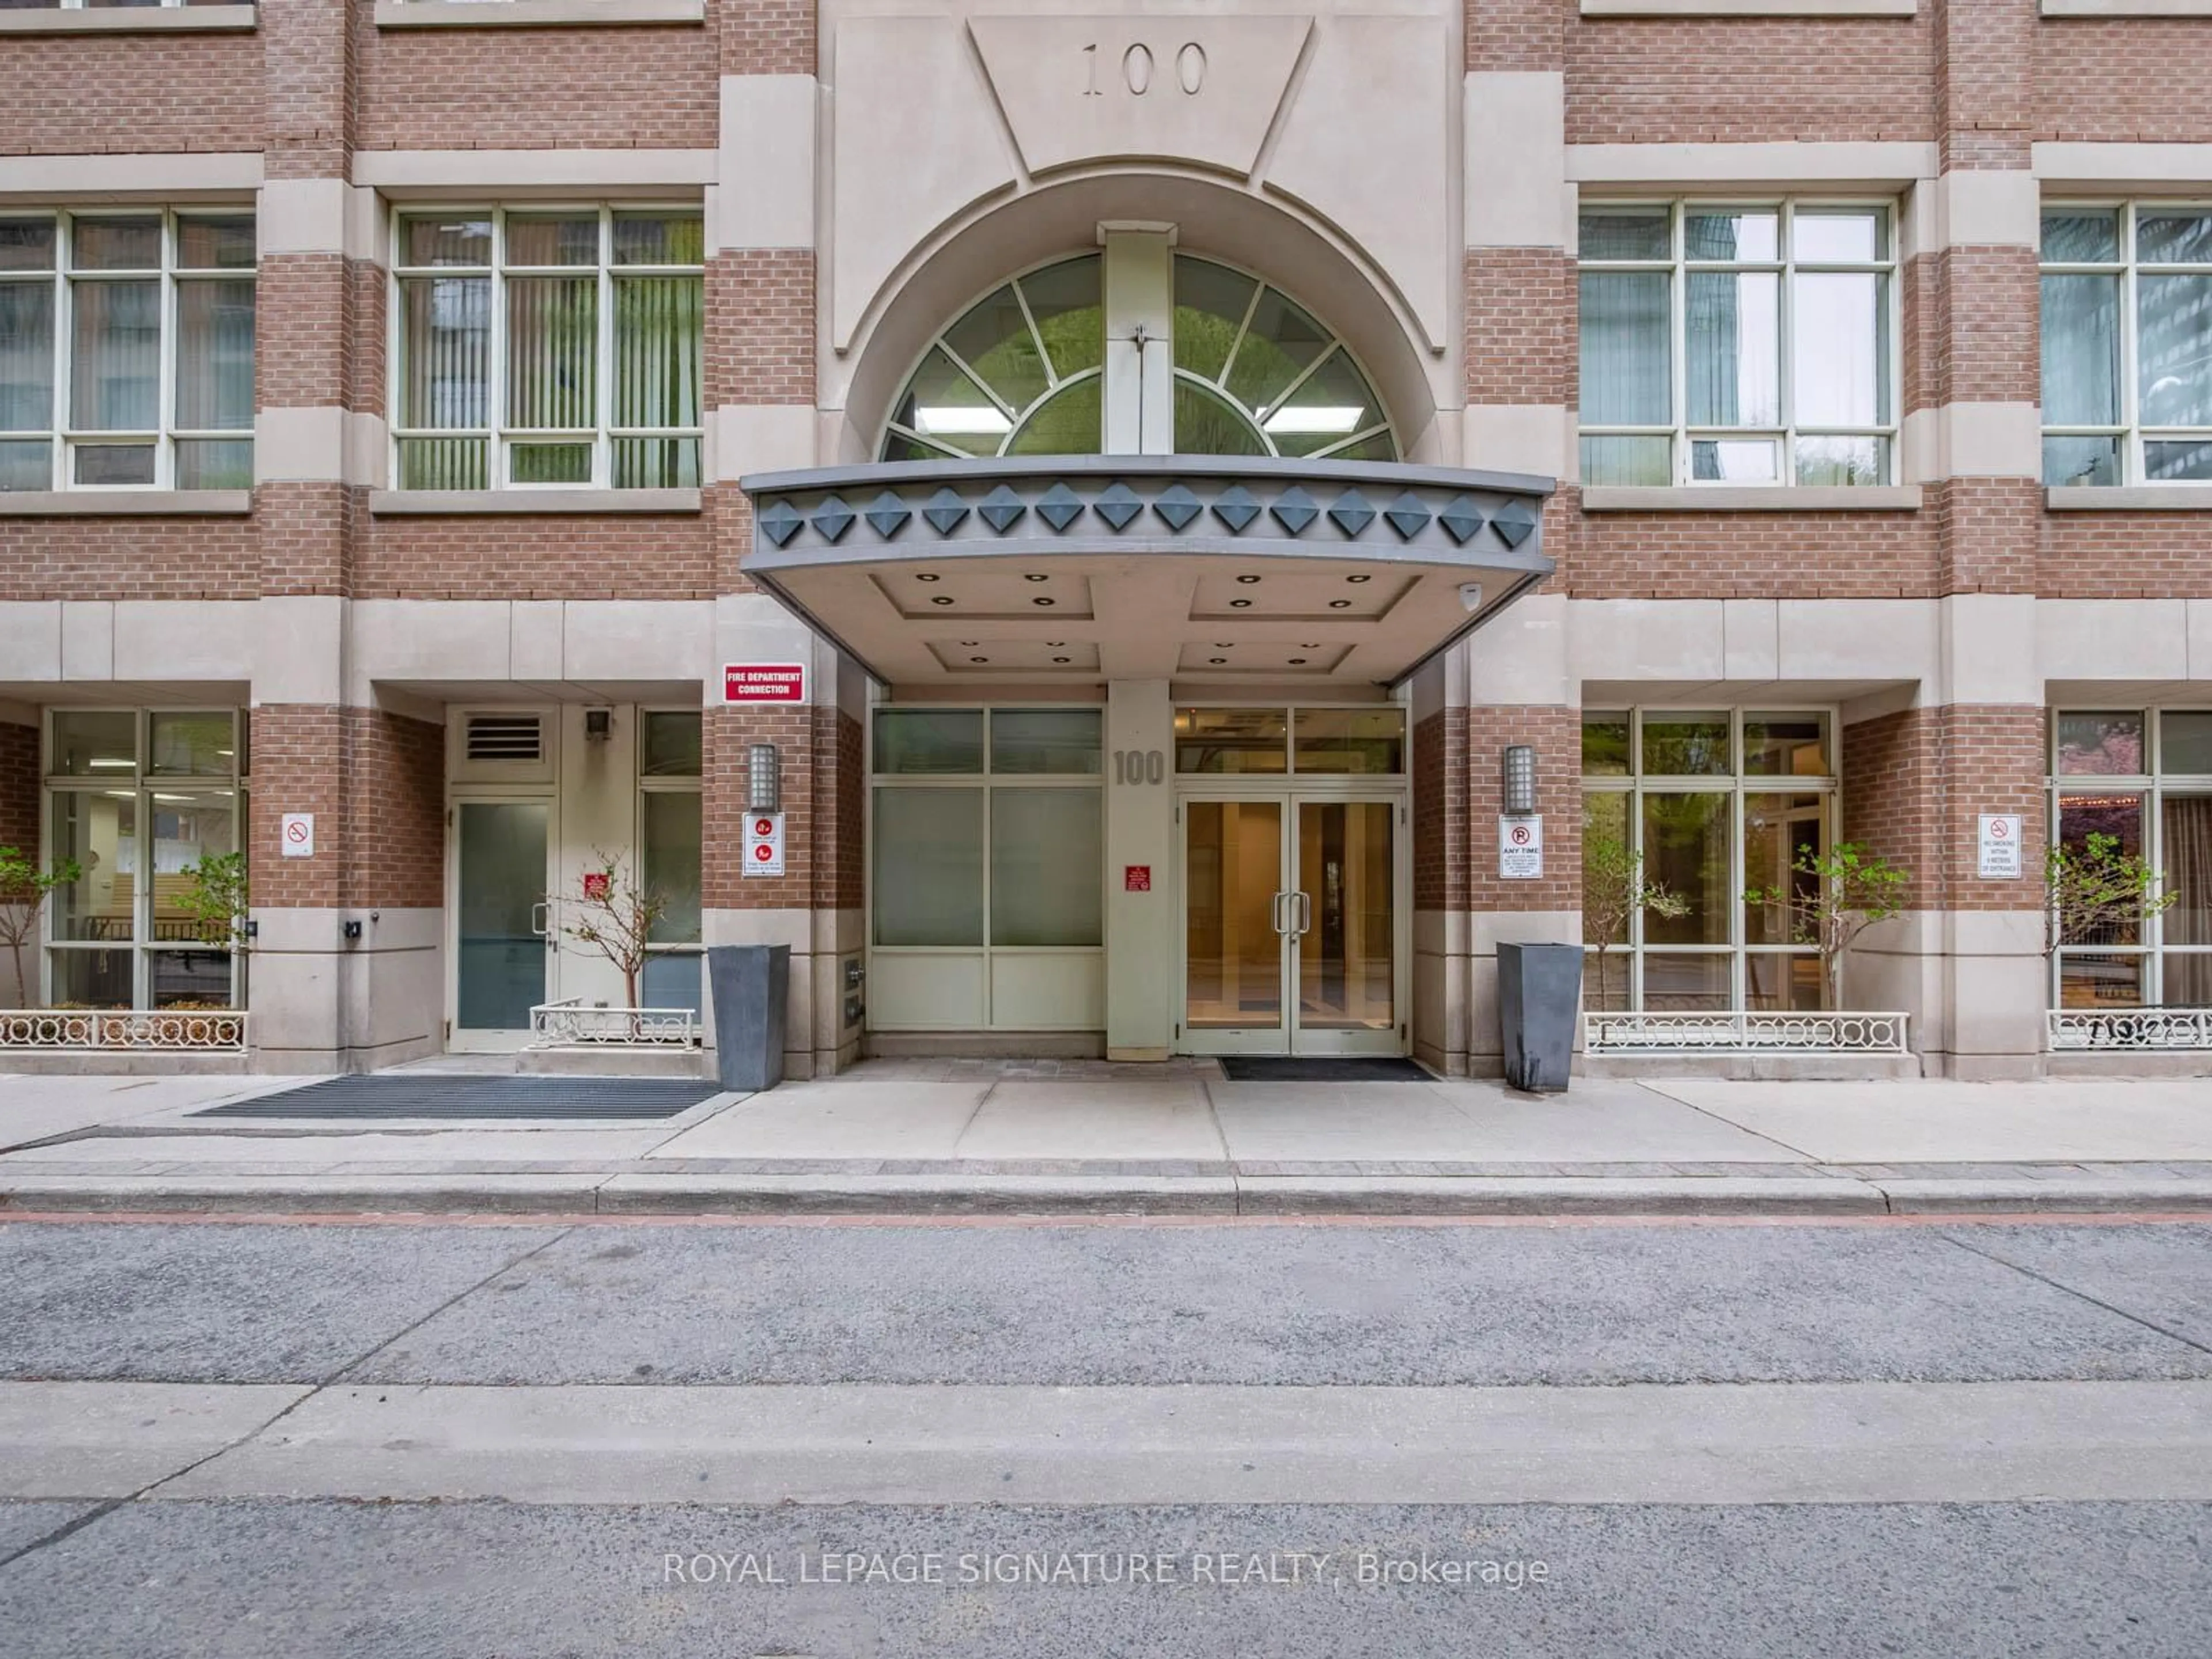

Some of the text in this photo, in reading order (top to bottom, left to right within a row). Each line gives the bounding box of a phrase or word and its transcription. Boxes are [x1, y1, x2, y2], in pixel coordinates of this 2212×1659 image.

[1082, 43, 1207, 96] 100
[727, 672, 801, 682] FIRE DEPARTMENT
[738, 684, 790, 694] CONNECTION
[1113, 750, 1164, 786] 100
